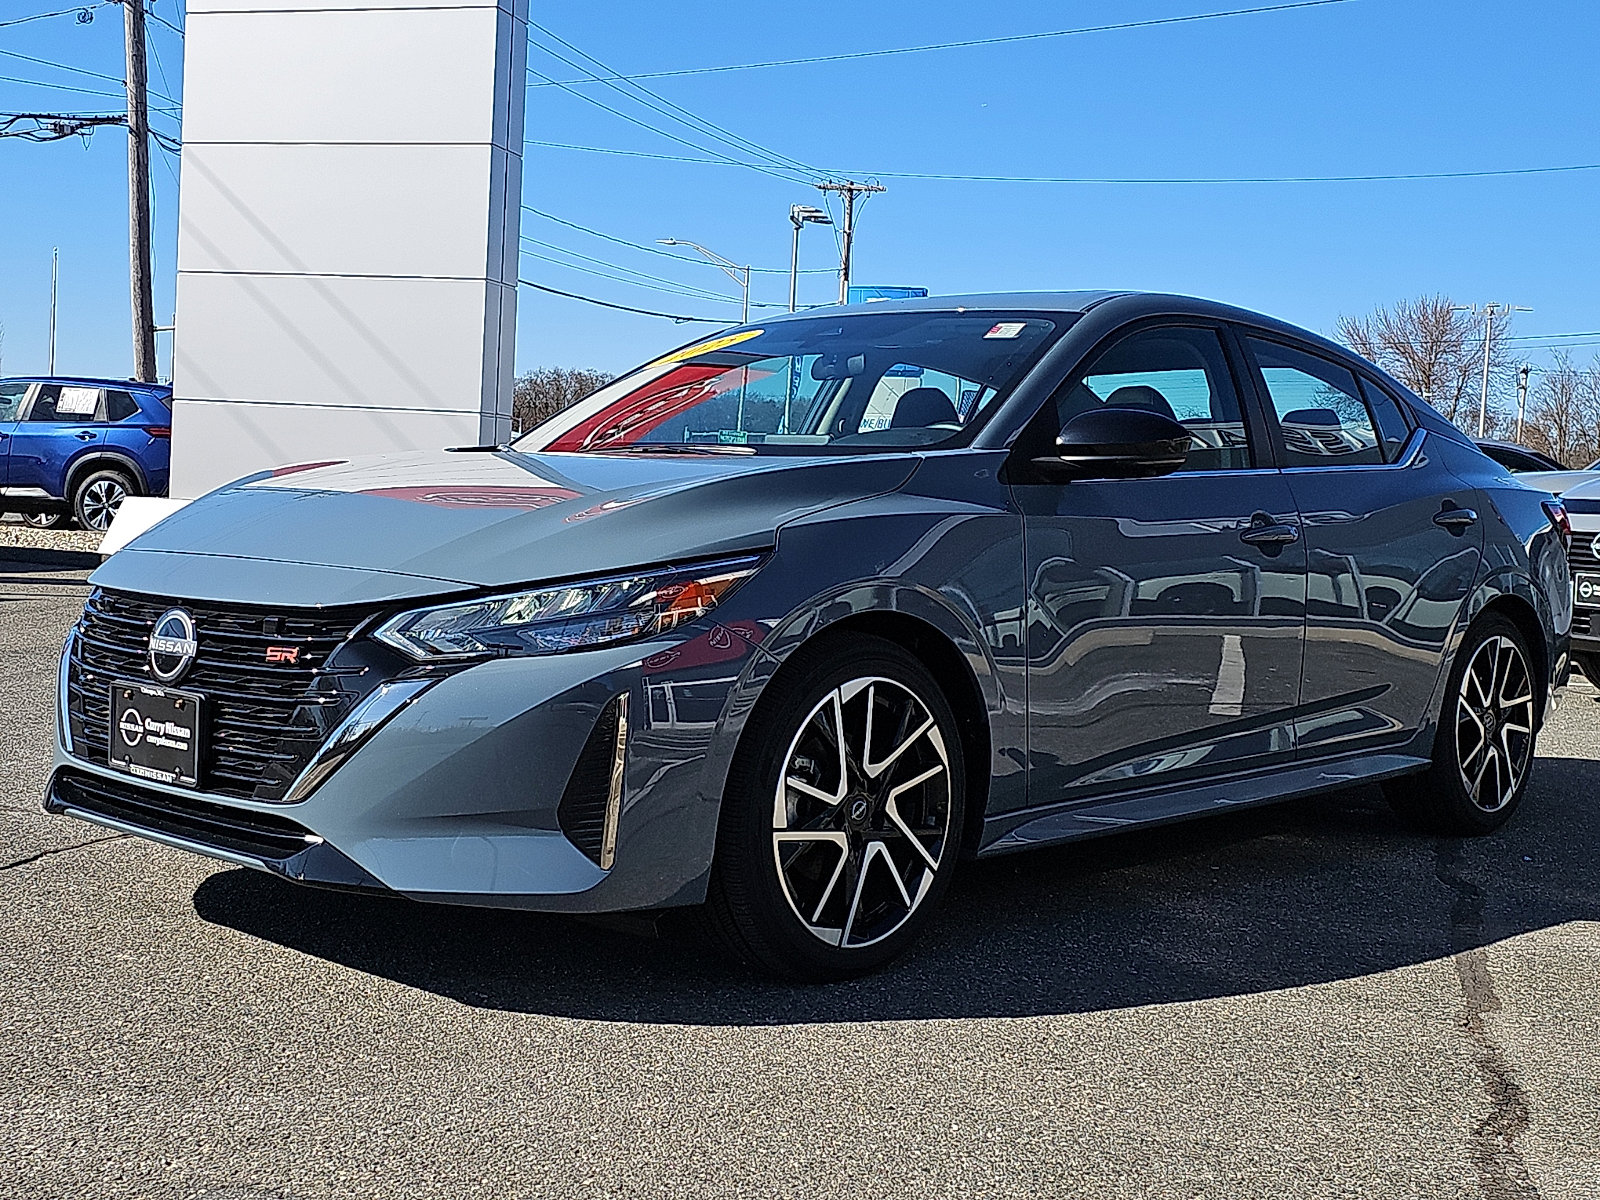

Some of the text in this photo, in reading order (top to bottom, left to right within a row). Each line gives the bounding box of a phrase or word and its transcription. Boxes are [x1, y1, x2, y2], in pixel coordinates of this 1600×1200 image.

[149, 637, 196, 656] NISSAN
[266, 646, 299, 664] SR
[145, 717, 191, 739] Curry Nissan
